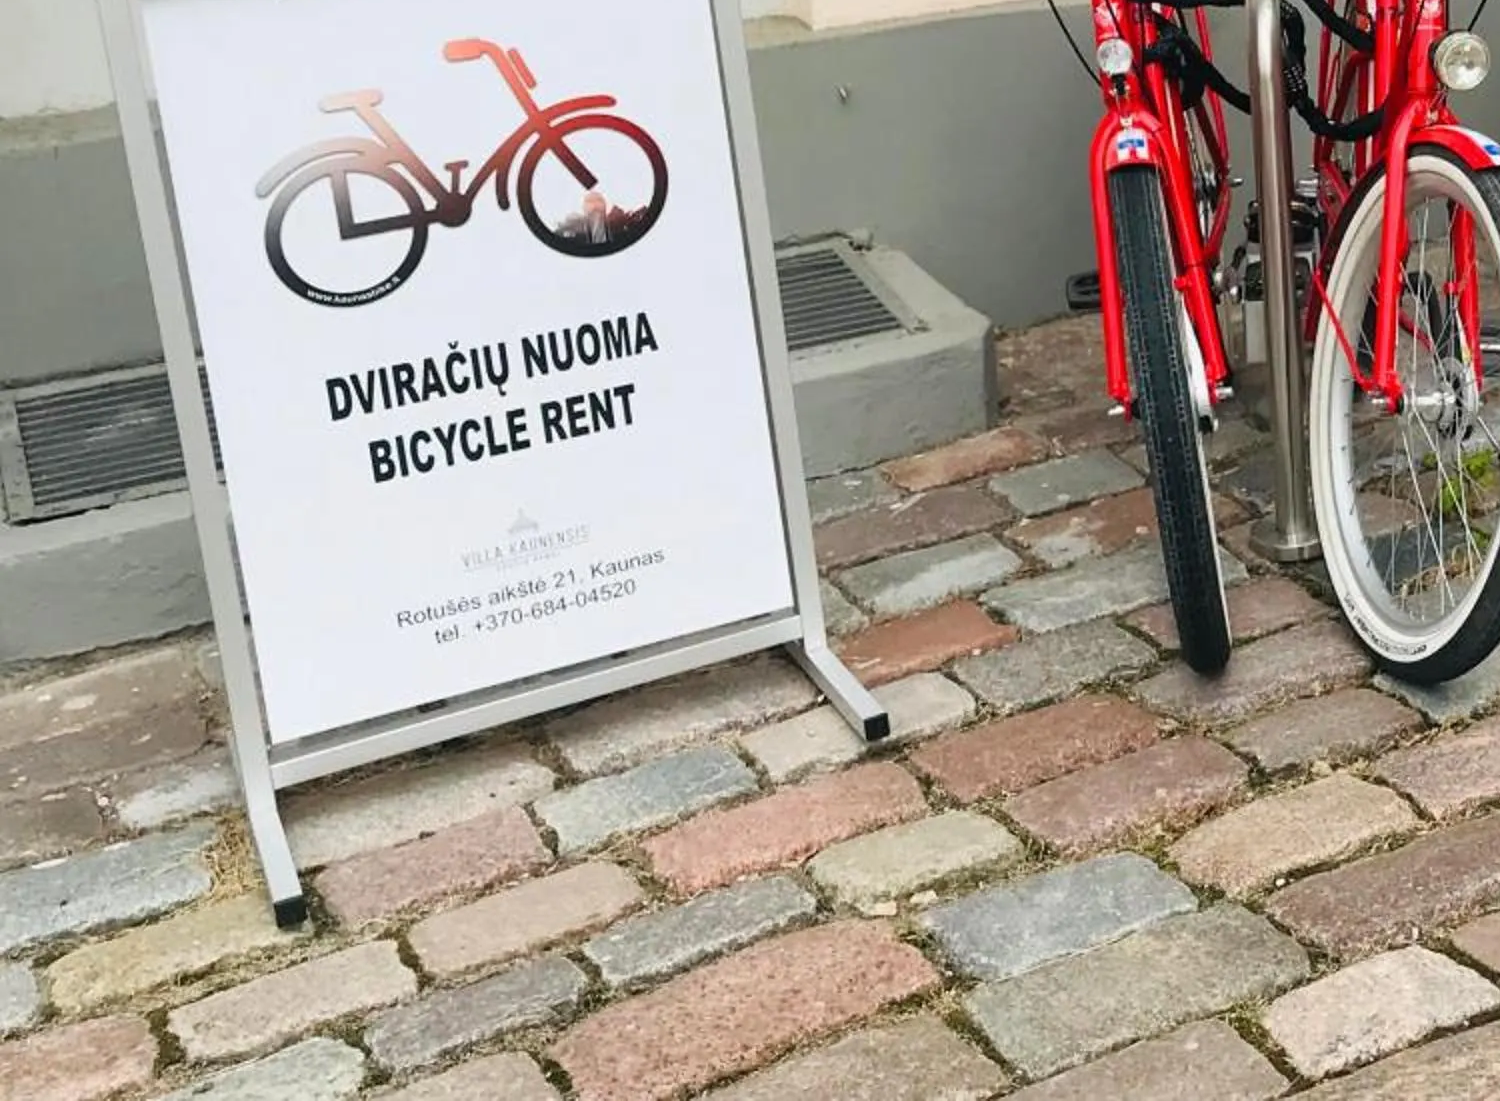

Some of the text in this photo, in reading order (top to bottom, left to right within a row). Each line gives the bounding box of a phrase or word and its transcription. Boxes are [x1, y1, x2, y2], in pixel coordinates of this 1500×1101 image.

[325, 312, 659, 421] DVIRAČIŲ NUOMA
[368, 383, 636, 483] BICYCLE RENT
[396, 595, 482, 628] Rotušės
[589, 549, 666, 580] Kaunas
[460, 546, 504, 569] VILLA
[475, 578, 638, 635] +370-684-04520
